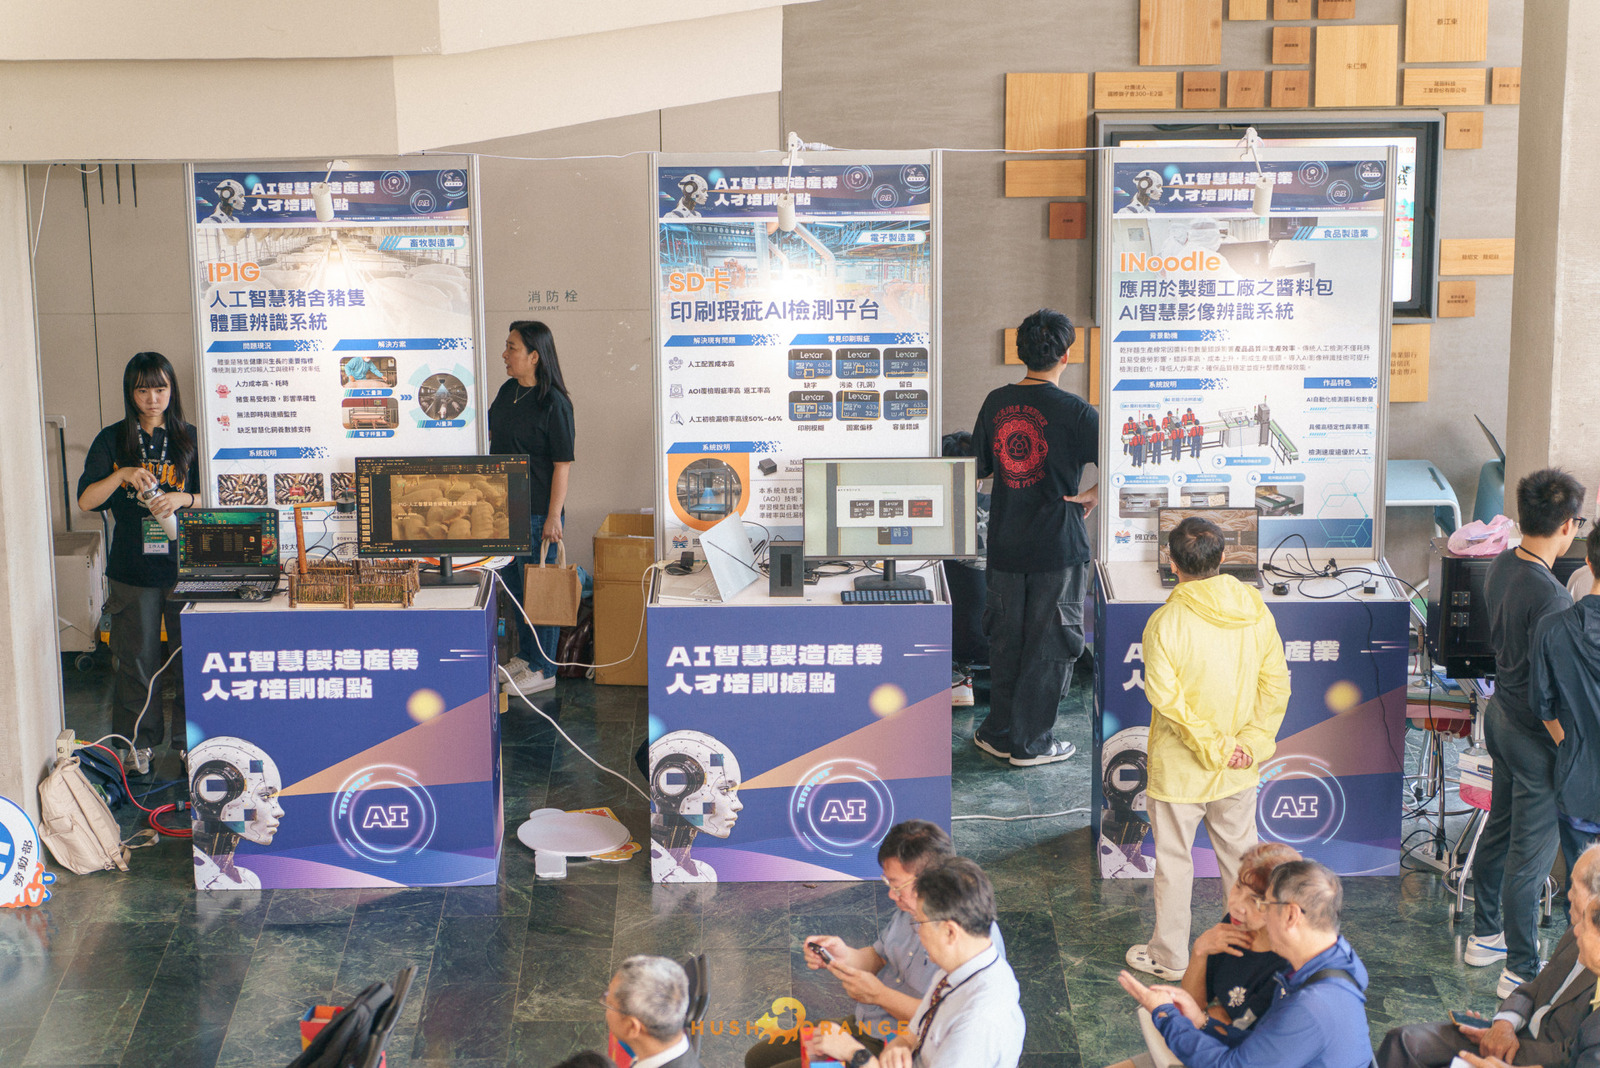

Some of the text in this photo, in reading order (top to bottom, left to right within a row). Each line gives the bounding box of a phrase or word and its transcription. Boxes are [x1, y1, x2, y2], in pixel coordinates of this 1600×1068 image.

[251, 181, 376, 196] AI智慧造產業
[714, 176, 838, 190] AI智慧製造產業
[714, 193, 811, 207] 人才培訓點
[1168, 188, 1256, 202] 人才培訓據
[251, 198, 349, 212] 人才培訓點
[869, 233, 916, 243] 電子製造業
[1323, 229, 1369, 239] 食品製造業
[409, 238, 455, 248] 畜牧製造業
[1120, 251, 1221, 272] INoodle
[208, 262, 260, 282] IPIG
[669, 268, 731, 293] SD卡
[1119, 279, 1334, 298] 應用於製麵工廠之醬料包
[209, 288, 366, 308] 人工智慧豬舍豬隻
[528, 289, 578, 303] 消防栓
[670, 298, 880, 323] 印刷瑕疵AI檢測平台
[1119, 302, 1294, 322] AI智慧影像辨識系統
[209, 313, 328, 332] 體重辨識系統
[242, 341, 272, 350] 問題現況
[377, 340, 407, 349] 解決方案
[692, 336, 736, 345] 解決現有問題
[827, 335, 871, 344] 常見印刷瑕疵
[800, 351, 824, 359] Lexar
[847, 350, 871, 359] Lexar
[895, 350, 919, 358] Lexar
[1149, 380, 1177, 389] 系統說明
[1323, 379, 1352, 387] 作品特色
[801, 393, 825, 401] Lexar
[848, 391, 872, 401] Lexar
[895, 391, 919, 400] Lexar
[248, 449, 277, 458] 系統說明
[702, 443, 731, 451] 系統說明
[1177, 475, 1182, 483] 2
[202, 649, 419, 673] AI智慧製造產業
[666, 643, 883, 667] AI智慧製造產業
[202, 677, 373, 701] 人才培訓據點
[666, 672, 836, 695] 人才培訓據點
[820, 799, 867, 821] AI
[1272, 796, 1318, 818] AI
[362, 805, 409, 828] AI
